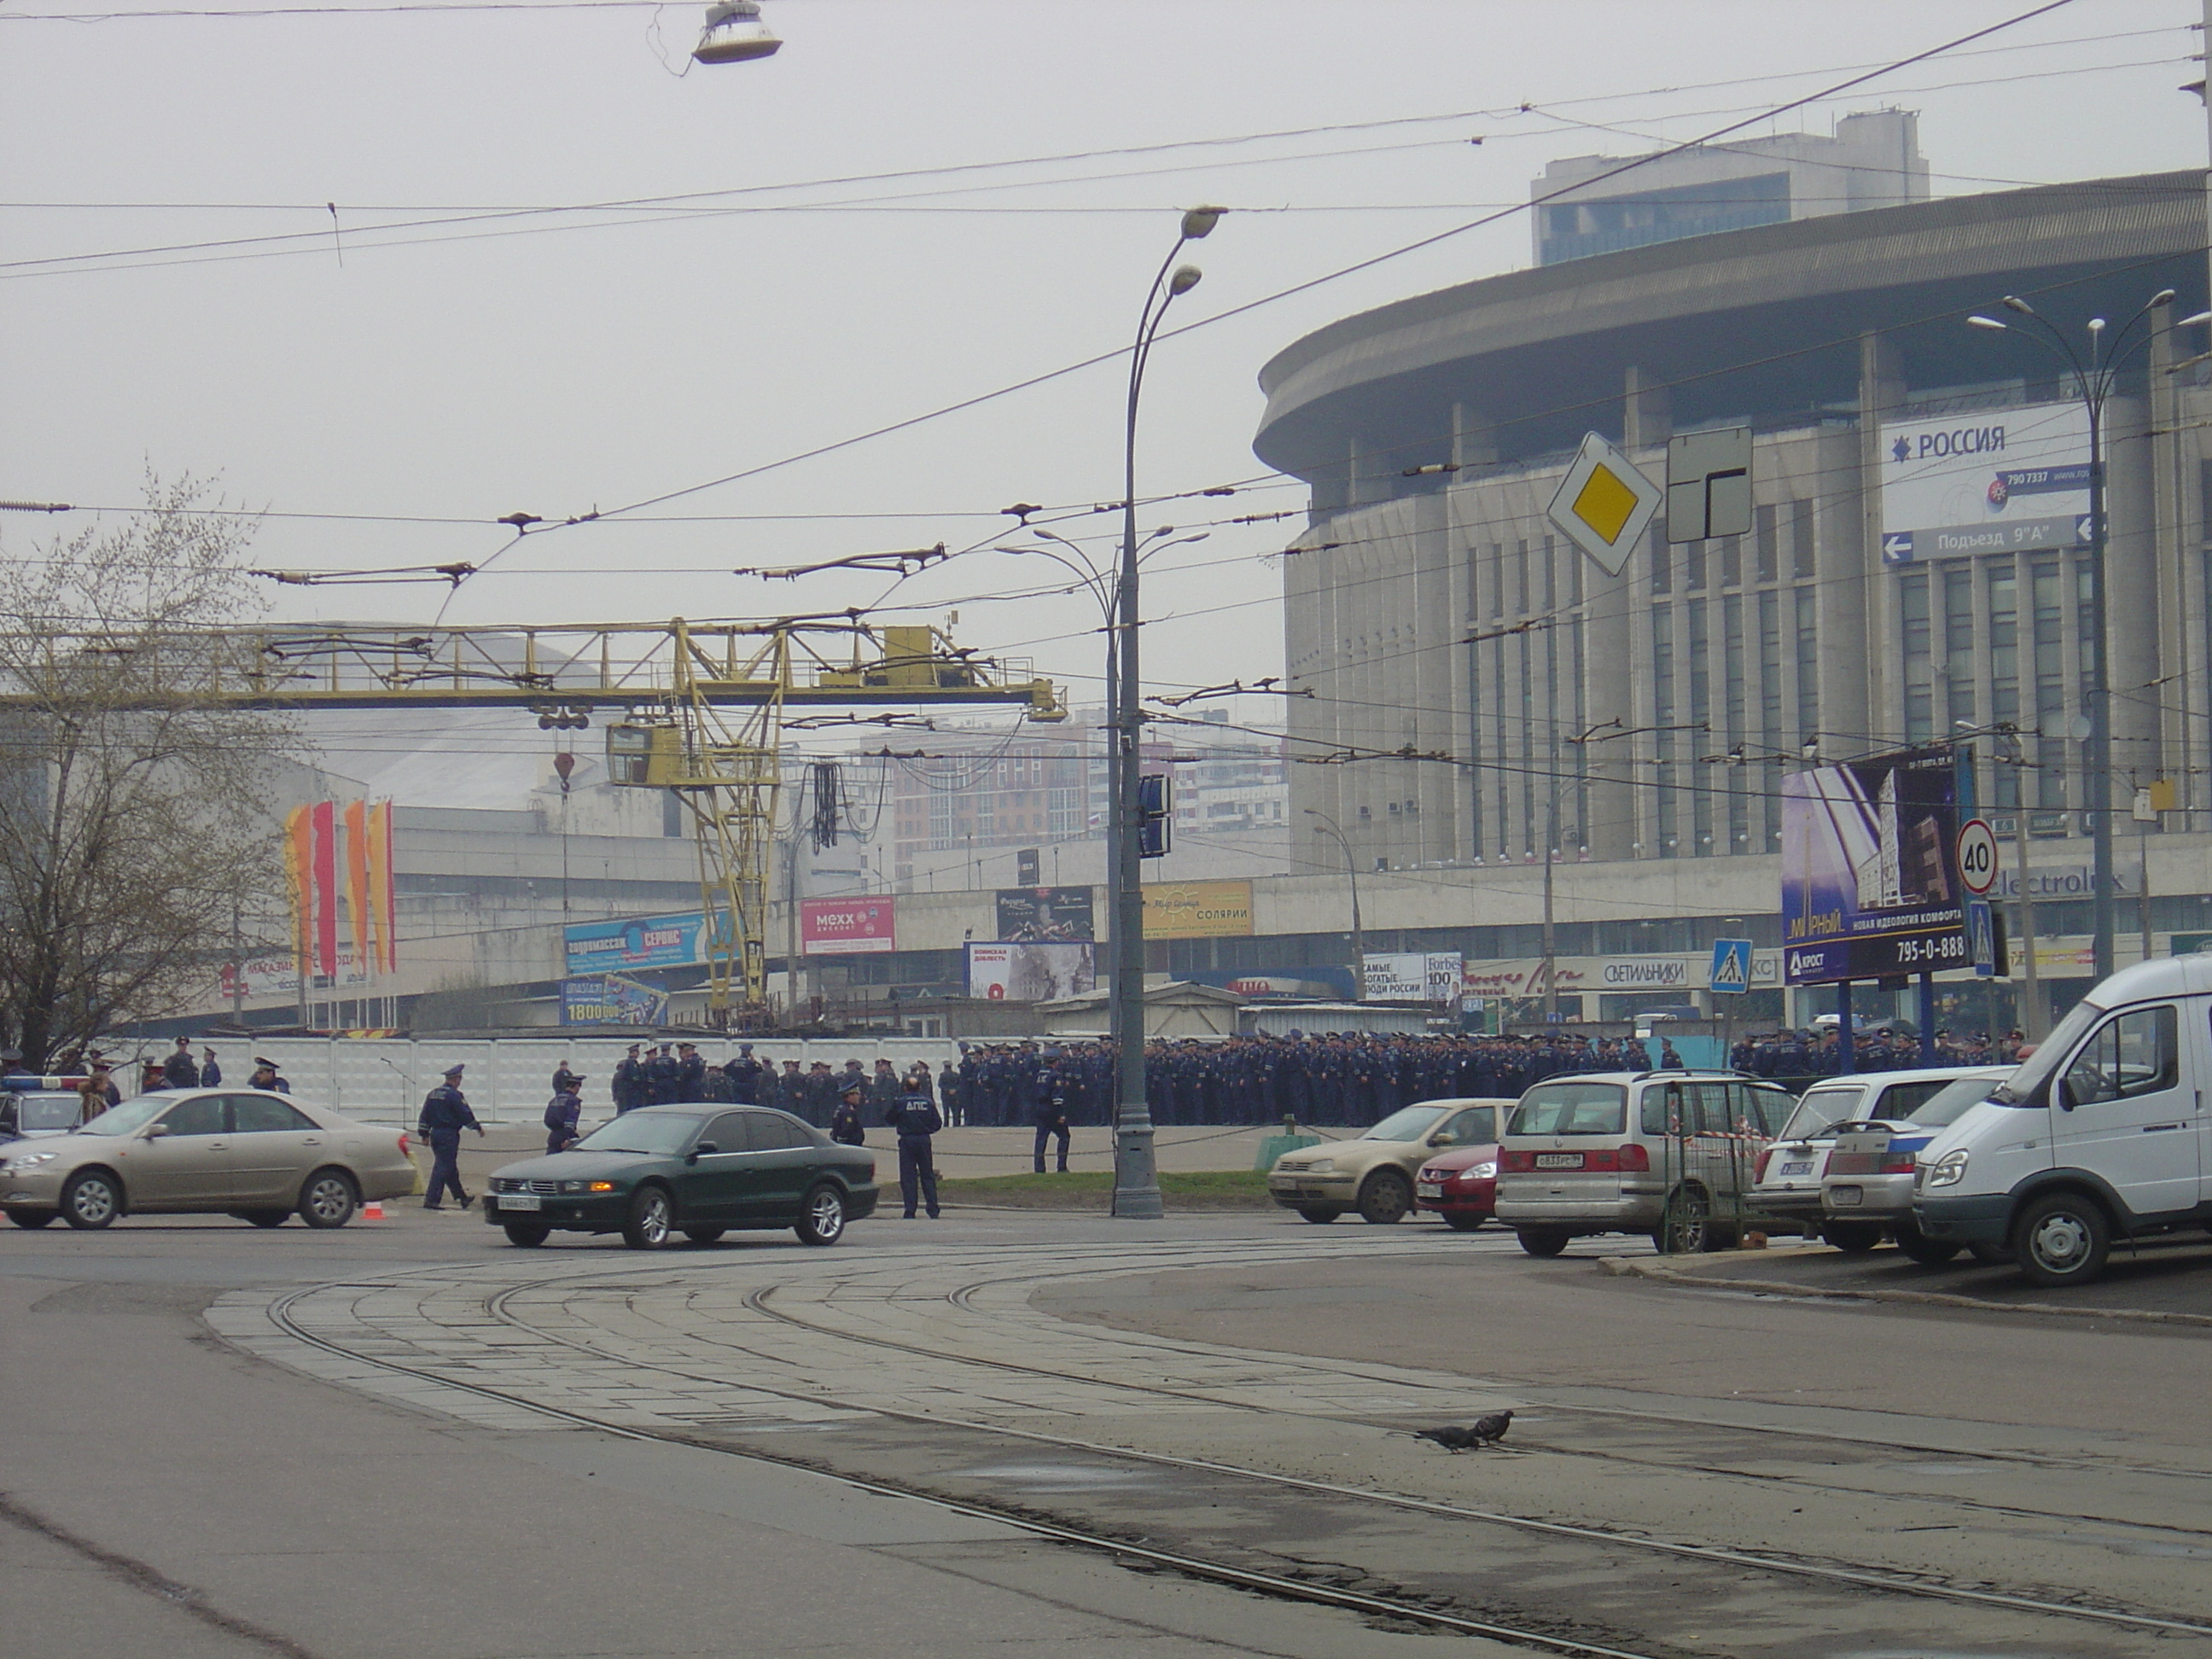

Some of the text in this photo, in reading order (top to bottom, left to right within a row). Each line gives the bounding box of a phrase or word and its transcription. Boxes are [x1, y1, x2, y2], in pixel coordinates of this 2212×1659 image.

[1919, 426, 2005, 459] РОССИЯ
[2007, 469, 2091, 485] 790 7337 www.ros
[1937, 531, 2005, 550] Подъезд
[1965, 842, 1989, 873] 40
[1196, 909, 1248, 920] СОЛЯРИИ
[1920, 909, 1962, 923] КОМФОРТА
[644, 929, 680, 946] СЕРВИС
[1897, 936, 1964, 963] 795-0-888
[1428, 972, 1451, 986] 100
[1604, 963, 1685, 982] СВЕТИЛЬНИКИ
[1389, 983, 1421, 993] РОССИИ
[906, 1101, 928, 1111] ДПС
